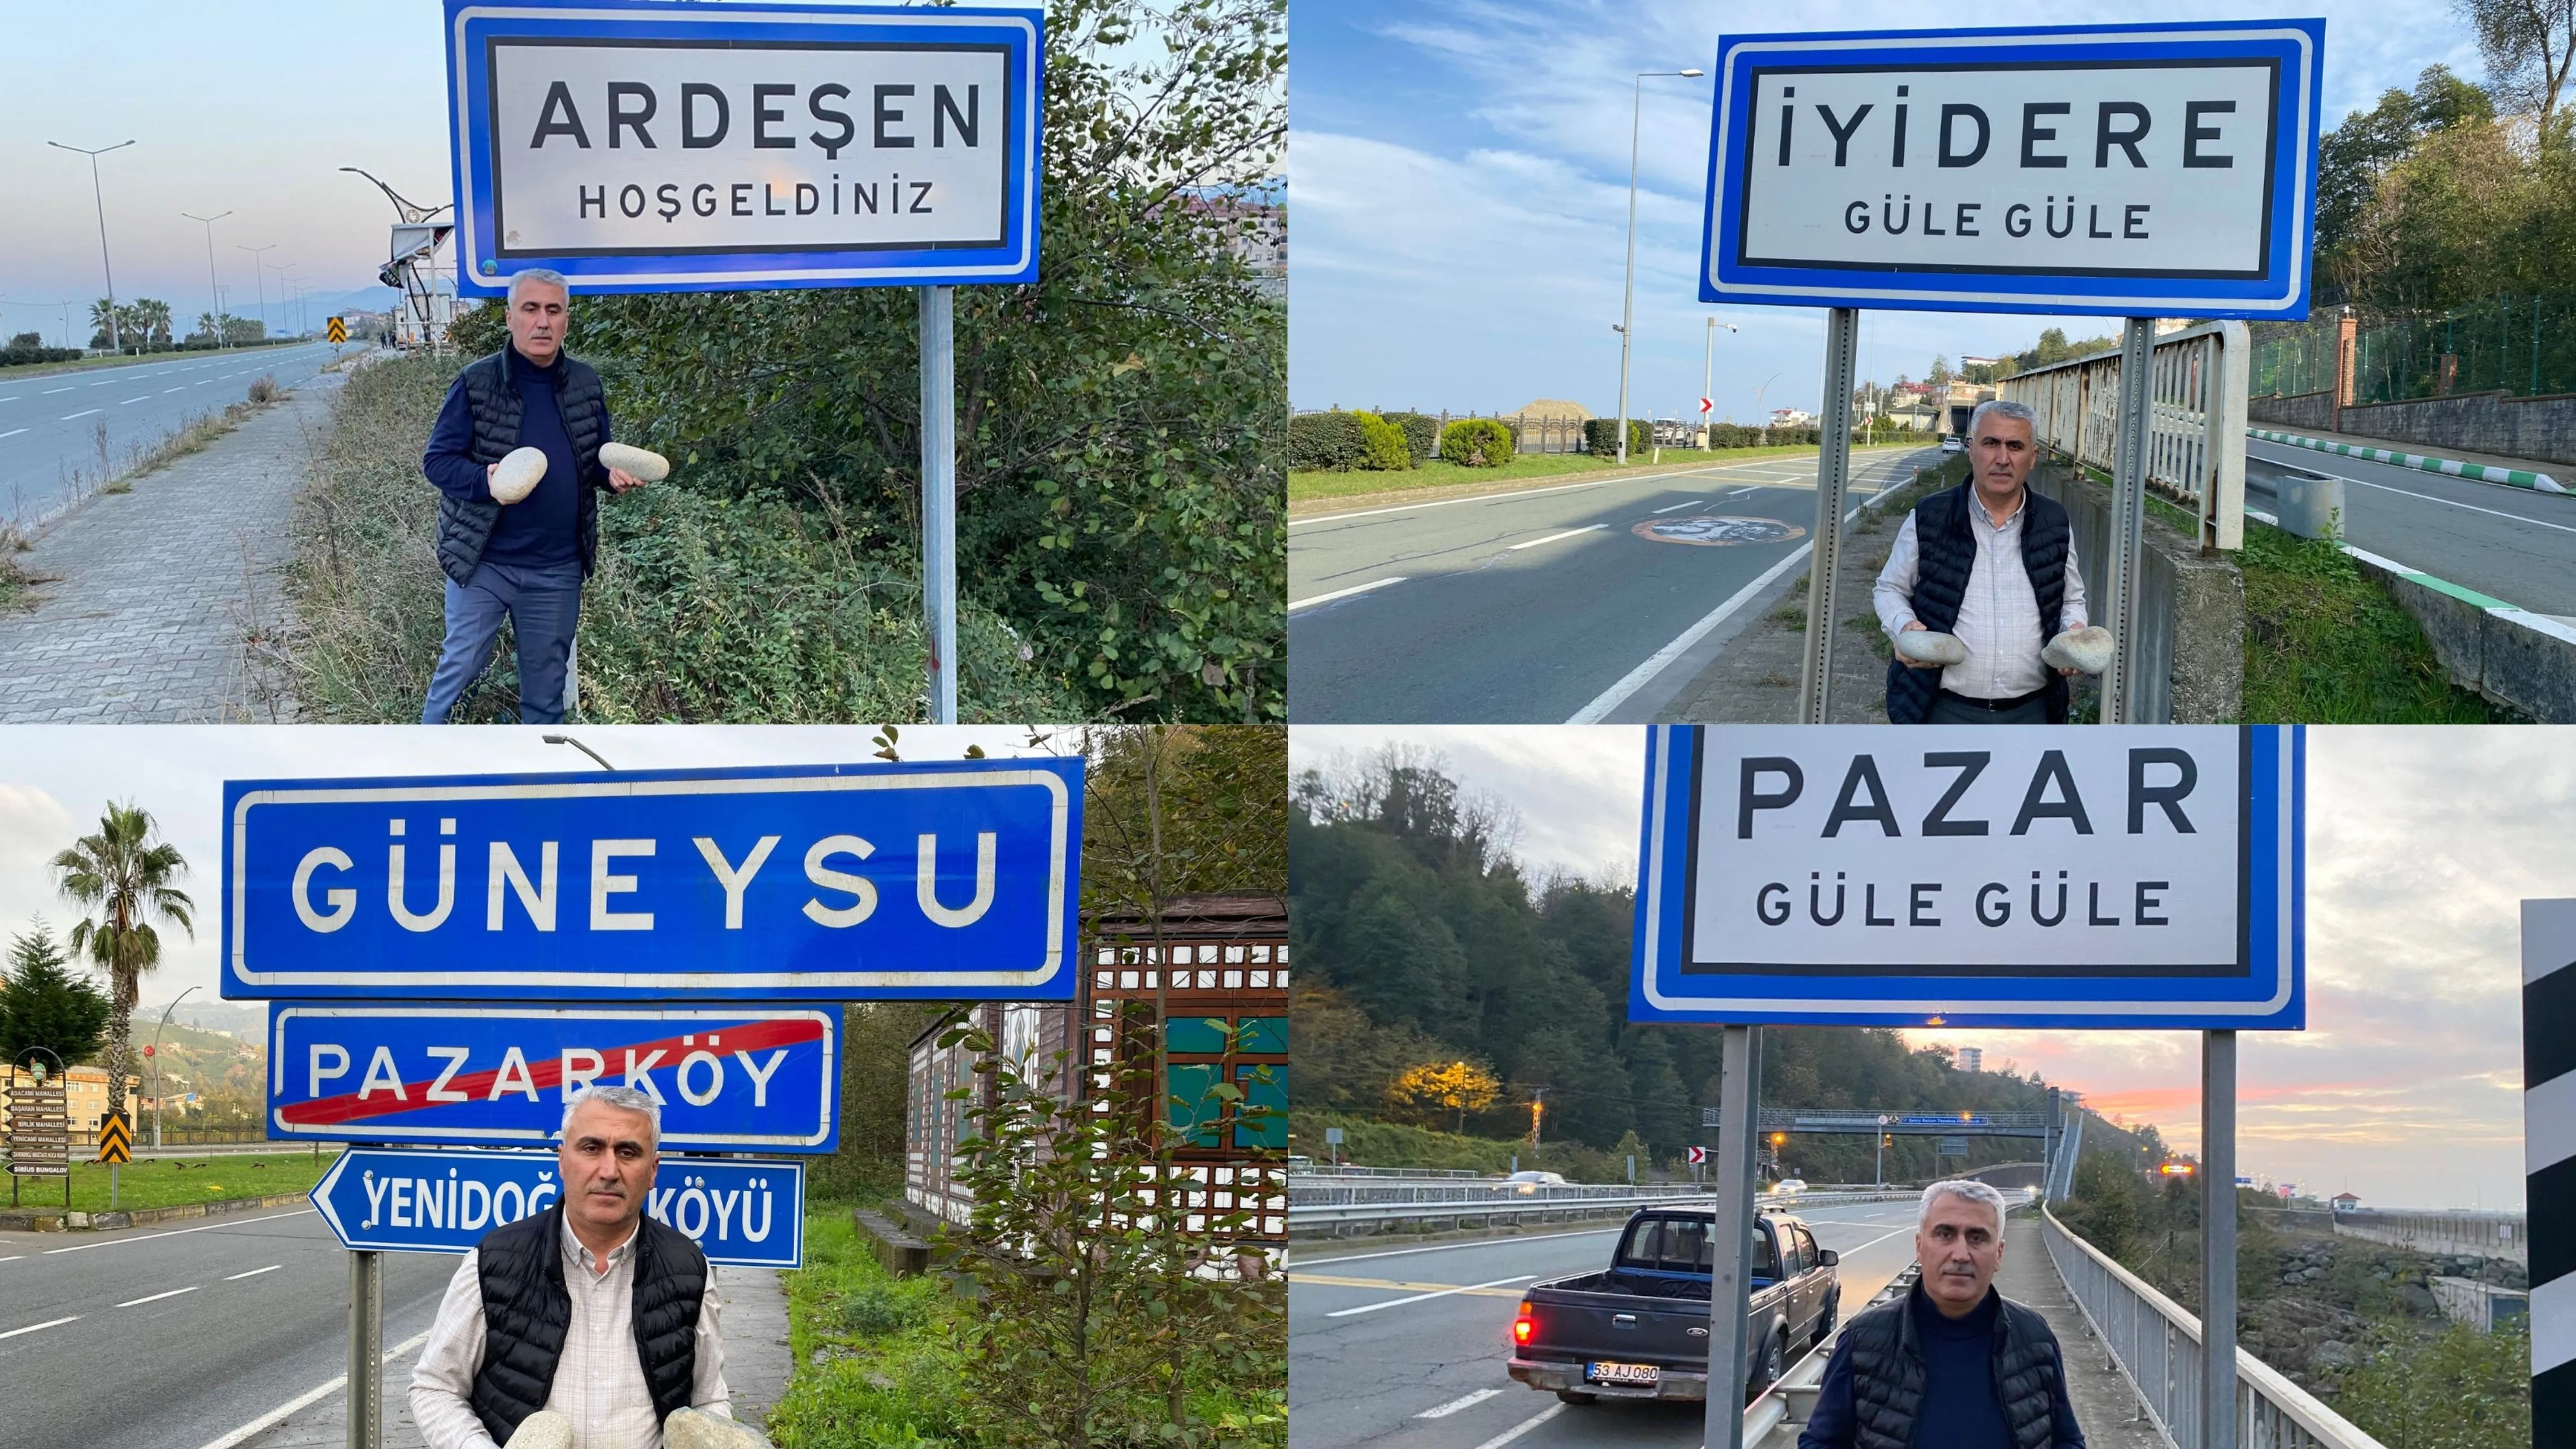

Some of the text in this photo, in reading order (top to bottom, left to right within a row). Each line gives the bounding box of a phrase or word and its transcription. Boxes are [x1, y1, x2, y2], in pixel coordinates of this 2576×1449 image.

[529, 80, 979, 160] ARDEŞEN
[1778, 84, 2237, 169] İYİDERE
[579, 173, 933, 223] HOŞGELDİNİZ
[1845, 193, 2151, 240] GÜLE GÜLE
[1737, 747, 2198, 840] PAZAR
[291, 817, 997, 934] GÜNEYSU
[1756, 870, 2169, 928] GÜLE GÜLE
[309, 1034, 790, 1107] PAZARKÖY
[362, 1167, 772, 1243] YENİDOĞ KÖYÜ
[1594, 1364, 1658, 1380] 53 AJ 080
